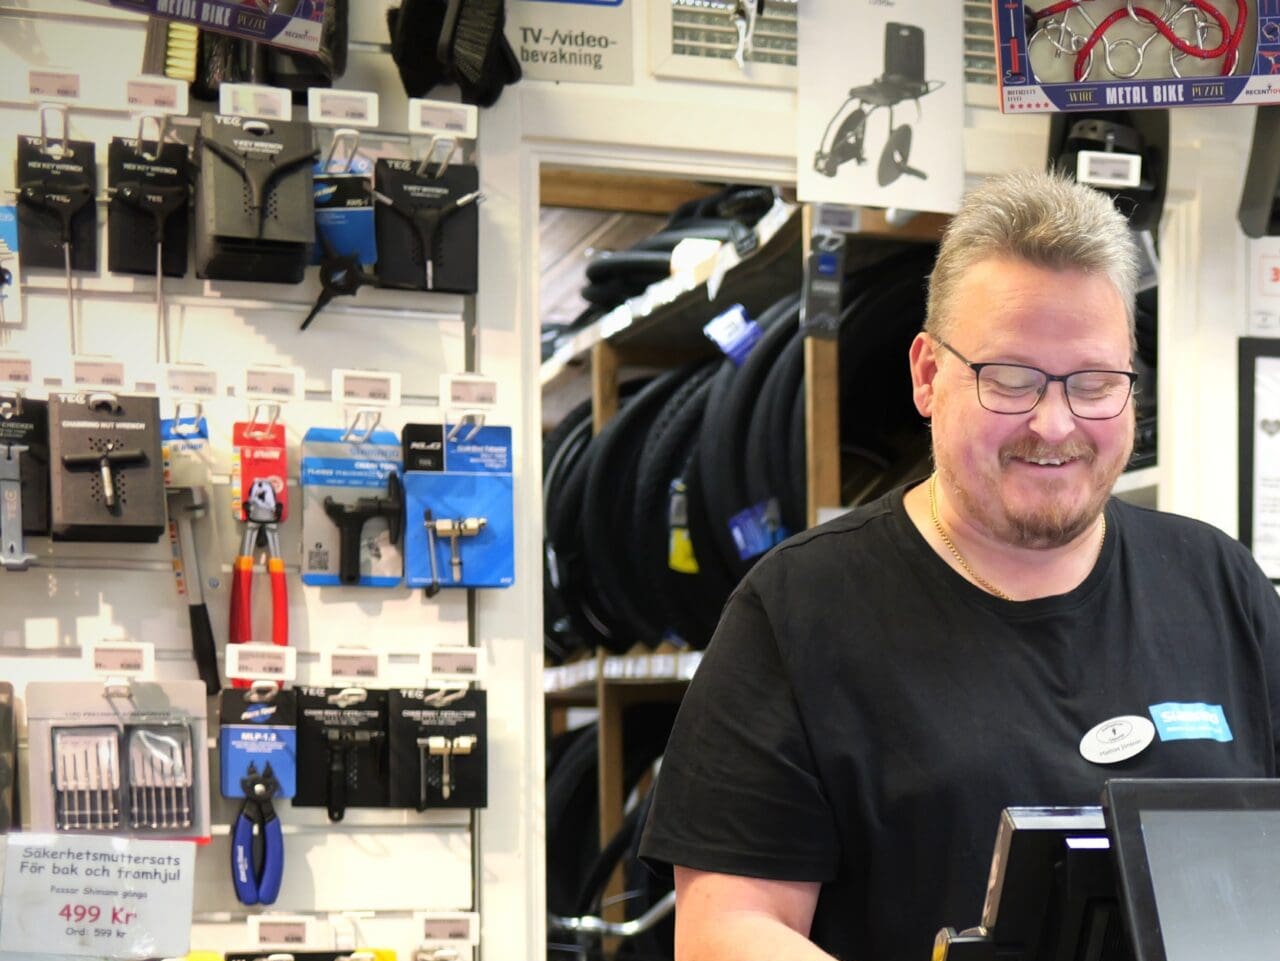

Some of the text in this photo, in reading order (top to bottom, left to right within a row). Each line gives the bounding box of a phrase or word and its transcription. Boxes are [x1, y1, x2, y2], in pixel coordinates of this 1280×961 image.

[201, 3, 231, 26] BIKE
[520, 27, 617, 48] TV-/video-
[520, 47, 602, 70] bevakning
[1106, 84, 1184, 104] METAL BIKE
[23, 848, 180, 866] Säkerhetsmuttersats
[20, 862, 180, 883] För bak och framhjul
[59, 904, 133, 924] 499 Kr
[94, 929, 112, 938] 599
[116, 930, 126, 938] kr
